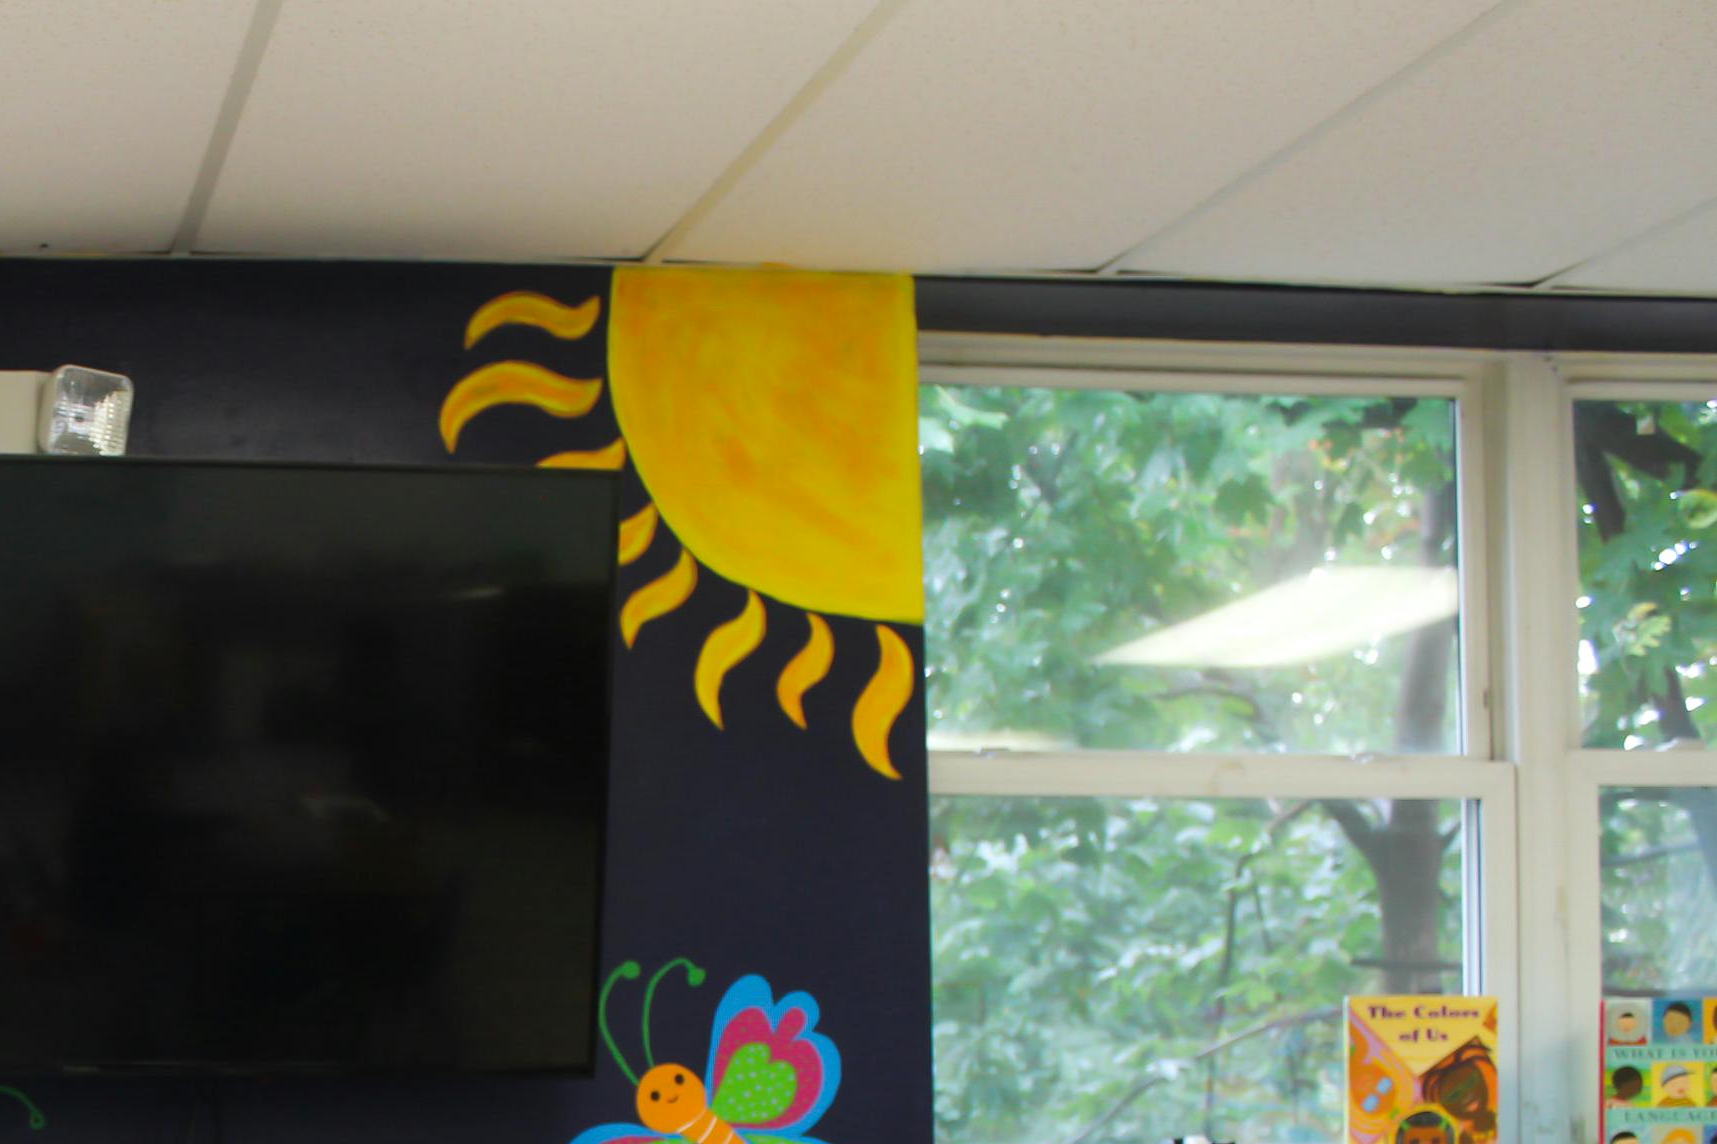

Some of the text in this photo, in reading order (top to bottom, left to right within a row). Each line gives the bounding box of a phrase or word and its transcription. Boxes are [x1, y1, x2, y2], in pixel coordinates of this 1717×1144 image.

[1368, 1005, 1479, 1019] The Colors
[1399, 1029, 1448, 1042] of Us
[1614, 1049, 1662, 1059] WHAT
